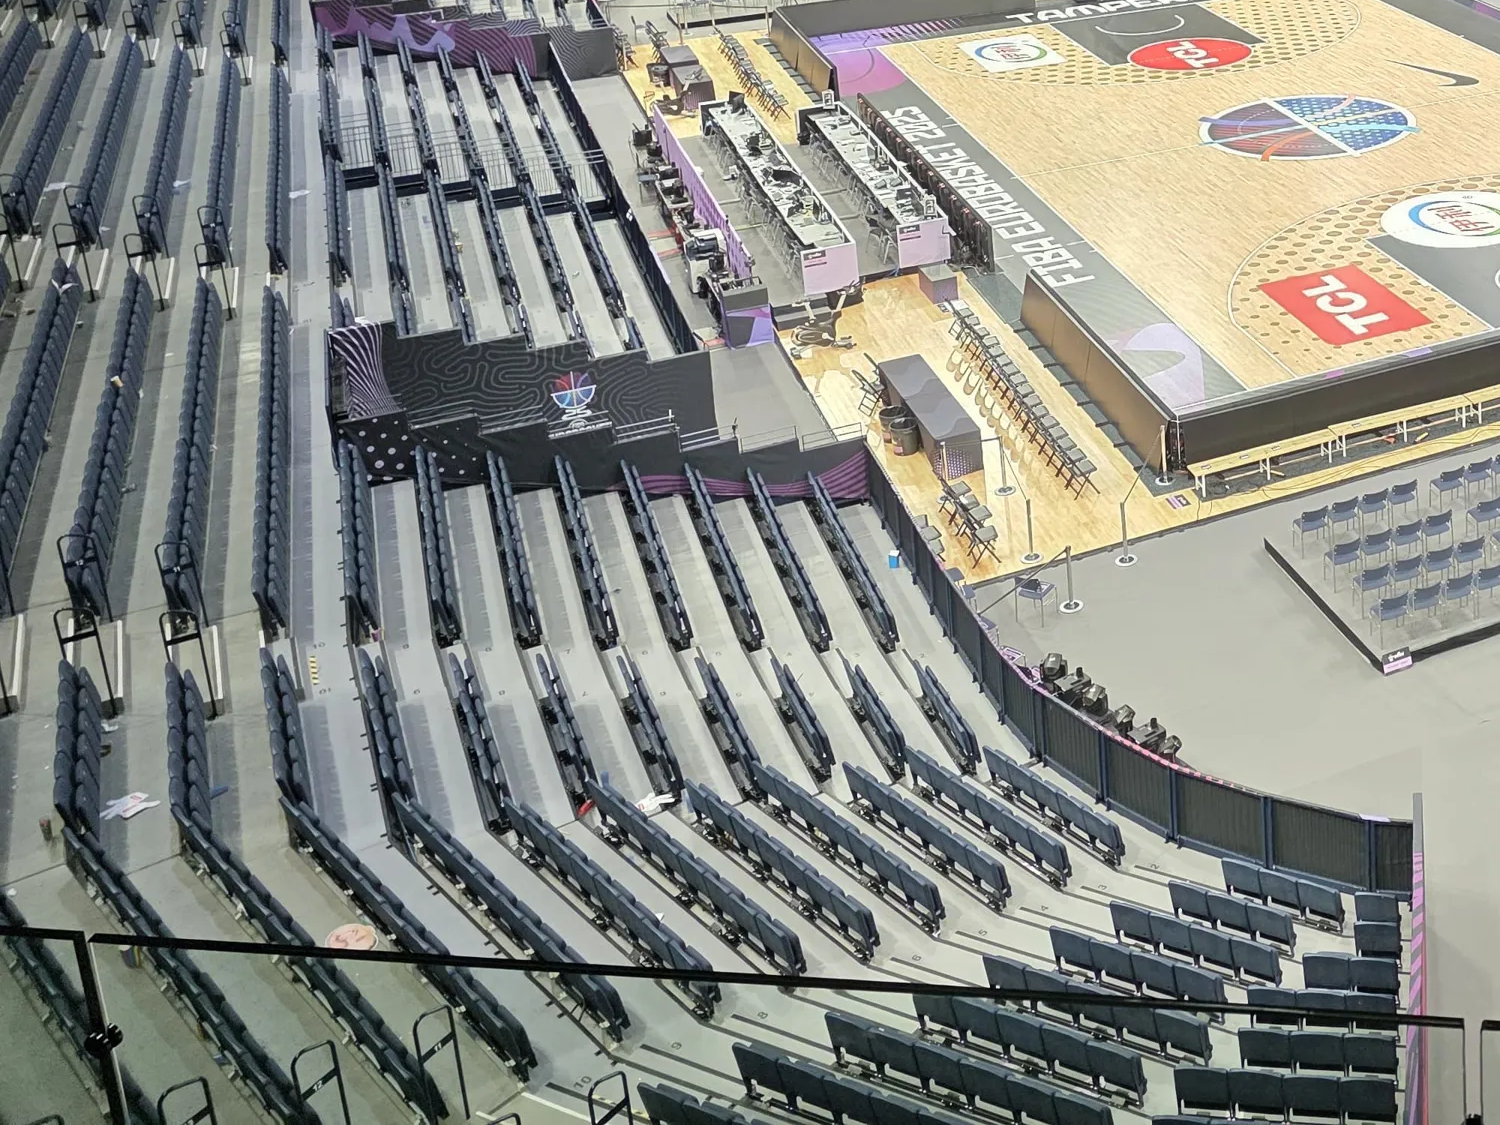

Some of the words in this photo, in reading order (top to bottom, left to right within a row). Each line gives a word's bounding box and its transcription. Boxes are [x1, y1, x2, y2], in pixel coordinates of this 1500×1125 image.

[1166, 41, 1219, 69] TCL
[881, 106, 946, 141] 2025
[1011, 236, 1096, 288] FIBA
[1302, 275, 1390, 335] TCL
